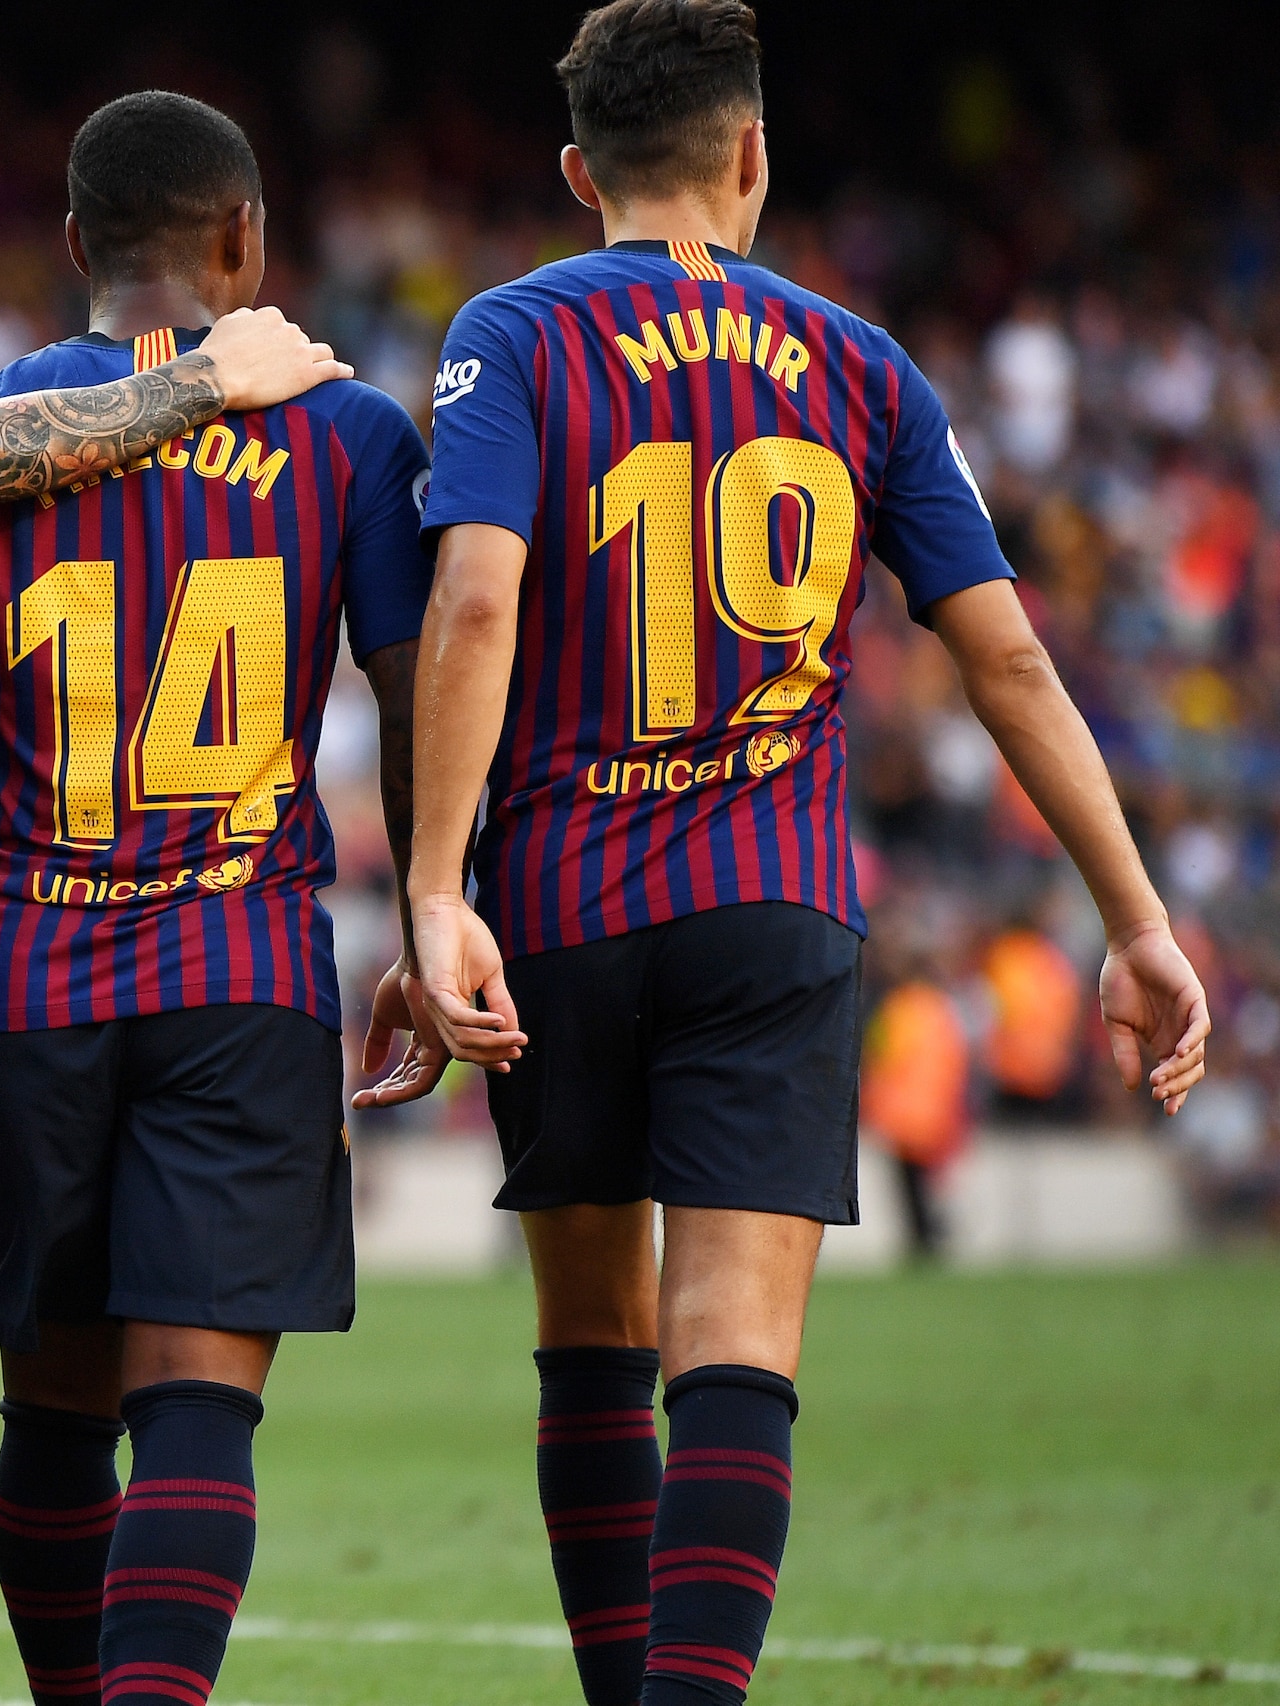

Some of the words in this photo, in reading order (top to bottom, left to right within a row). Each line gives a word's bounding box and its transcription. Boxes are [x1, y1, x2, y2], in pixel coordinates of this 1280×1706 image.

[613, 307, 811, 394] MUNIR
[589, 436, 856, 742] 19
[5, 556, 297, 850] 14
[32, 869, 193, 904] unicef
